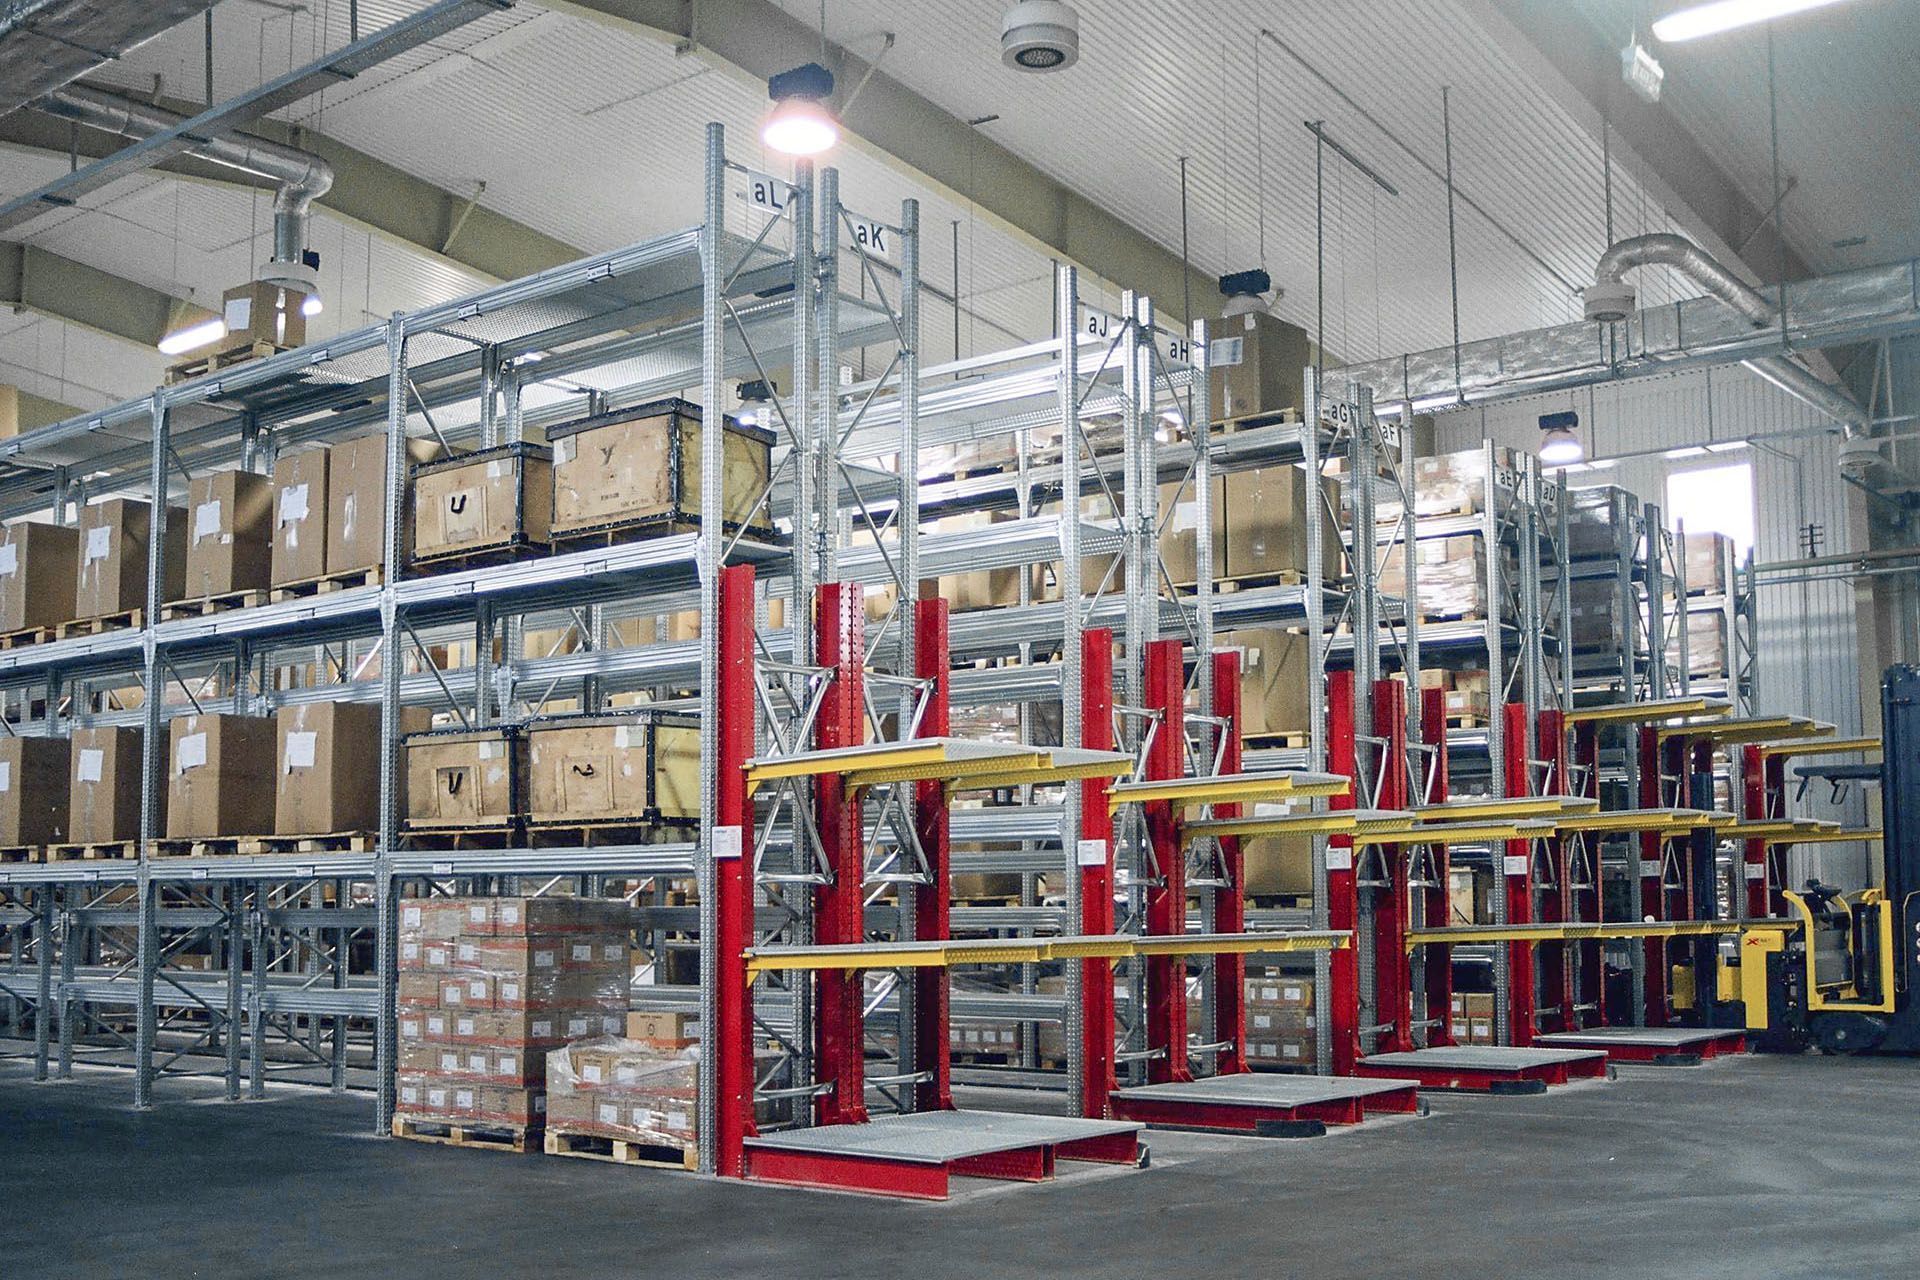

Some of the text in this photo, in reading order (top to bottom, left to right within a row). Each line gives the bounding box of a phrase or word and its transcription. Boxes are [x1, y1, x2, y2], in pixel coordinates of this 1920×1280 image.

[754, 181, 783, 210] aL
[857, 223, 885, 252] aK
[1088, 315, 1107, 337] aJ
[1170, 340, 1189, 363] aH
[1331, 403, 1347, 423] aG
[1382, 424, 1395, 441] aF
[1500, 470, 1513, 488] aE
[1543, 485, 1556, 502] aD
[1635, 520, 1646, 535] aC
